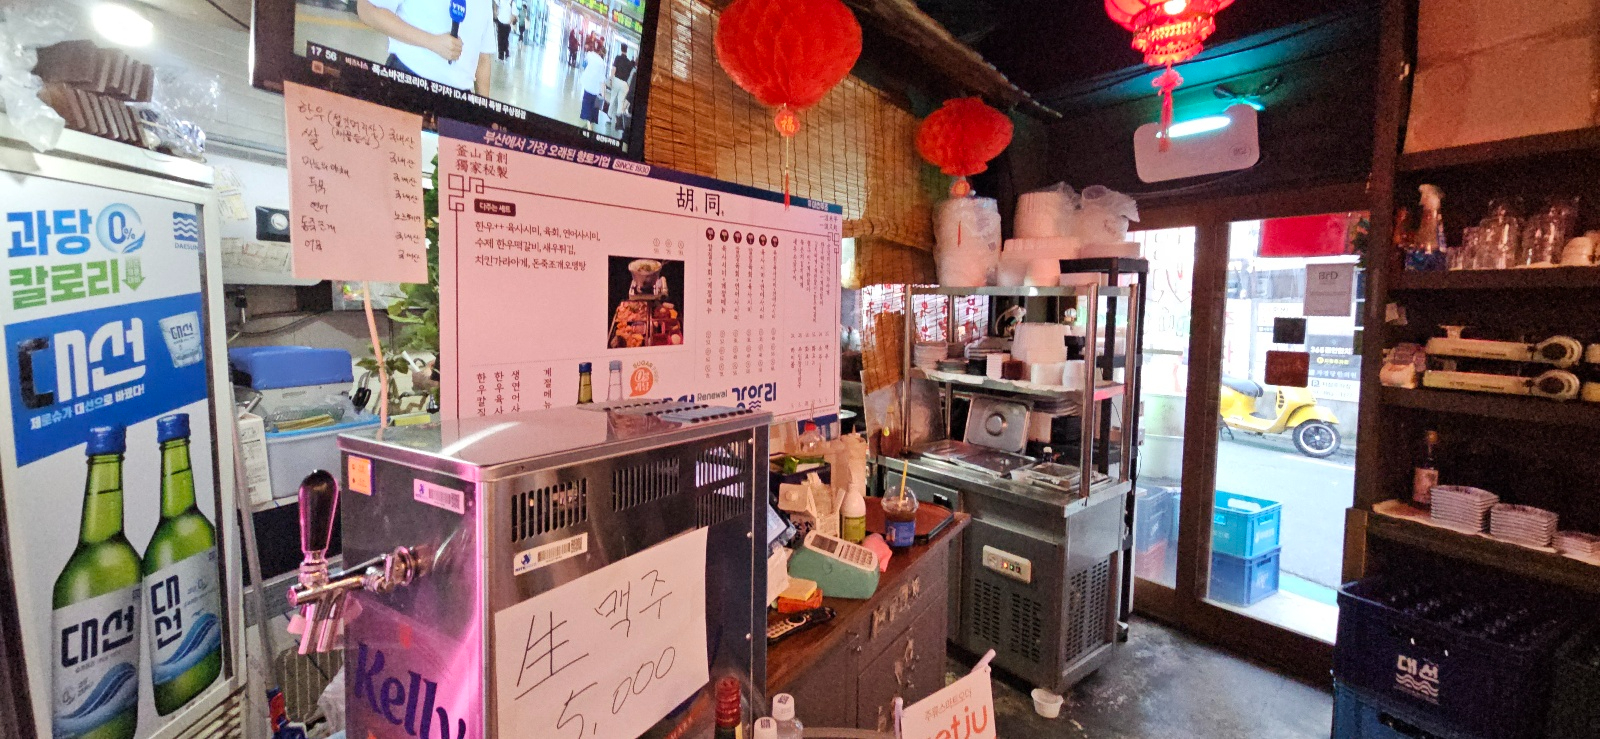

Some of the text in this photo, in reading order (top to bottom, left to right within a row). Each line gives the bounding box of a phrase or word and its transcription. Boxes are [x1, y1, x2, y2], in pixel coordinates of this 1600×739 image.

[311, 45, 322, 56] 17
[325, 51, 337, 61] 56
[371, 64, 429, 91] 폭스바겐코리아,
[431, 85, 453, 97] 전기차
[453, 90, 467, 101] ID.4
[467, 94, 488, 109] 배터리
[298, 100, 324, 121] 한우
[456, 144, 508, 165] 釜山首創
[483, 130, 526, 151] 부산에서
[527, 139, 548, 156] 가장
[548, 144, 576, 161] 오래된
[576, 150, 611, 168] 향토기업
[614, 161, 634, 171] SINCE
[456, 158, 509, 179] 獨家秘製
[310, 202, 328, 213] 연어
[676, 186, 721, 216] 胡同
[7, 208, 136, 258] 과당 0%
[475, 221, 601, 241] 한우++ 육사시미, 육회, 연어사시미,
[475, 238, 576, 255] 수제 한우떡갈비, 새우튀김,
[475, 254, 531, 268] 치킨가라아게,
[9, 258, 120, 310] 칼로리
[18, 317, 147, 409] 대선
[543, 367, 552, 410] 계절메뉴
[697, 390, 728, 402] Renewal
[30, 409, 73, 430] 제로슈가
[74, 396, 114, 415] 대선으로
[61, 605, 134, 668] 대선
[515, 570, 674, 701] 生 맥주
[1397, 655, 1440, 684] 대선
[354, 643, 466, 739] Kelly
[556, 646, 676, 739] 5,000
